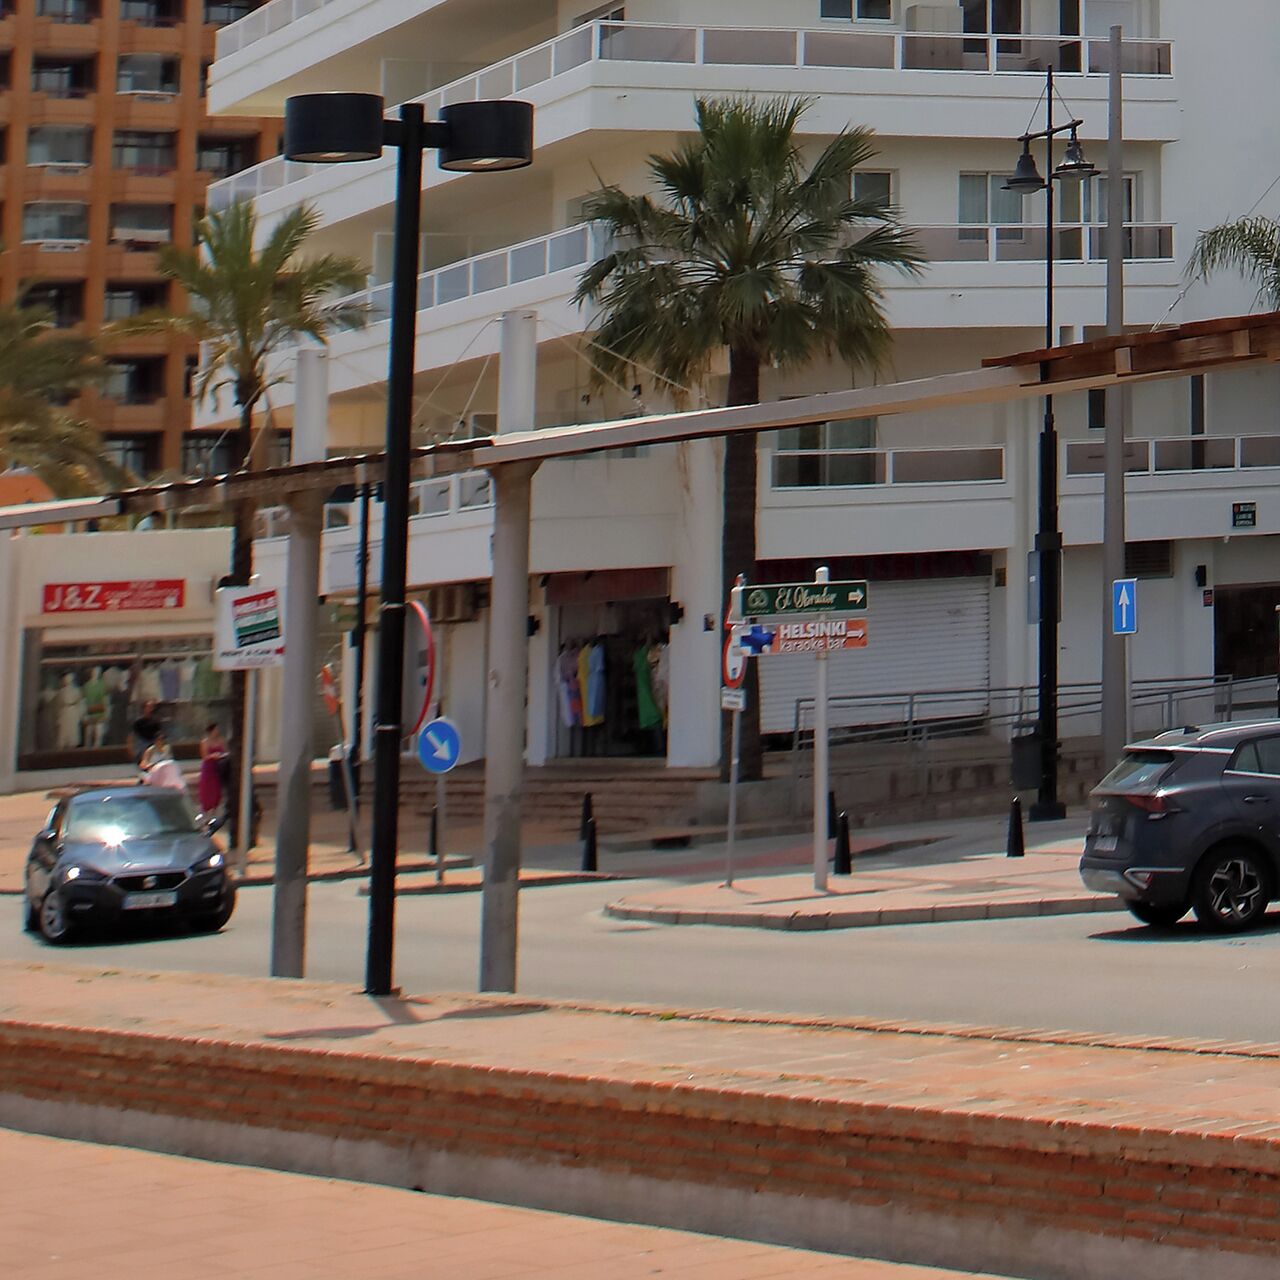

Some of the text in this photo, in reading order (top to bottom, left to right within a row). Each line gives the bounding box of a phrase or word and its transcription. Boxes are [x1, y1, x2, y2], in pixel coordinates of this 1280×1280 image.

[775, 586, 837, 610] El Obrador
[780, 621, 847, 639] HELSINKI
[780, 637, 847, 652] karaoke bar
